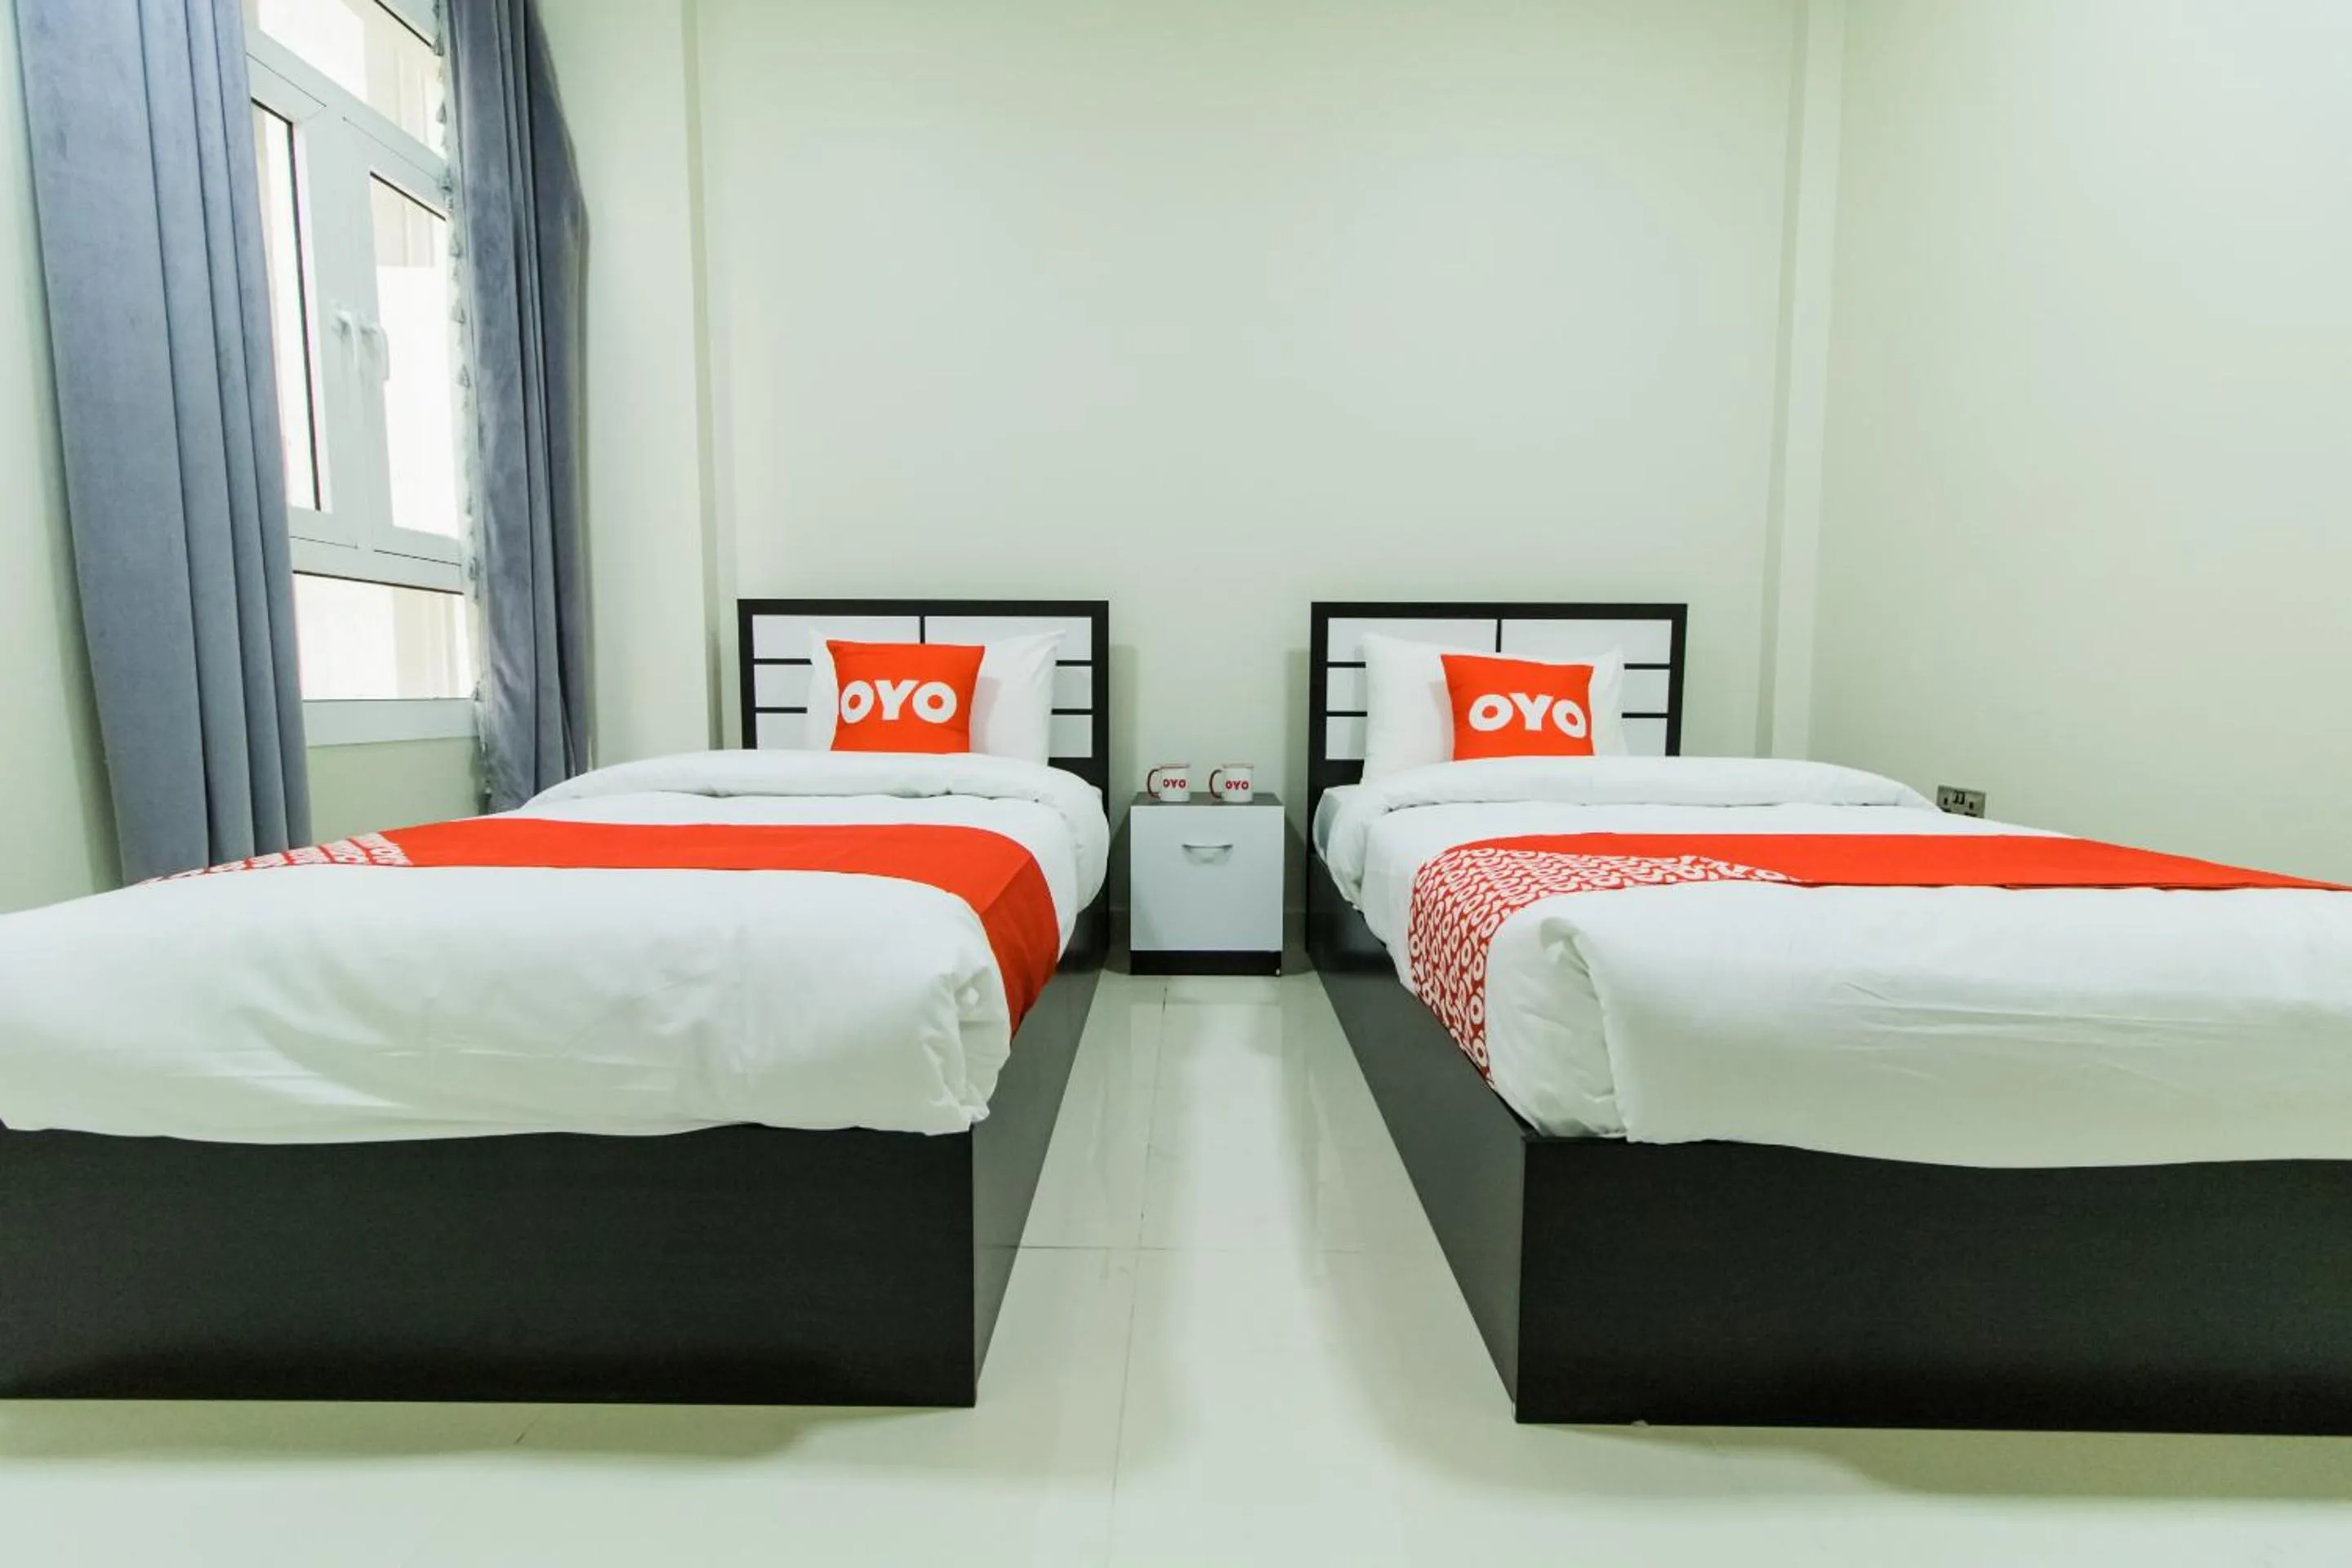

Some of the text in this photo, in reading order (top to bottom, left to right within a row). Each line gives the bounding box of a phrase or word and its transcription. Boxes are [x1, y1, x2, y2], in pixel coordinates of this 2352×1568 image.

[840, 679, 958, 724] OYO
[1468, 692, 1588, 739] OYO
[1162, 778, 1187, 789] OYO
[1225, 780, 1250, 791] OYO
